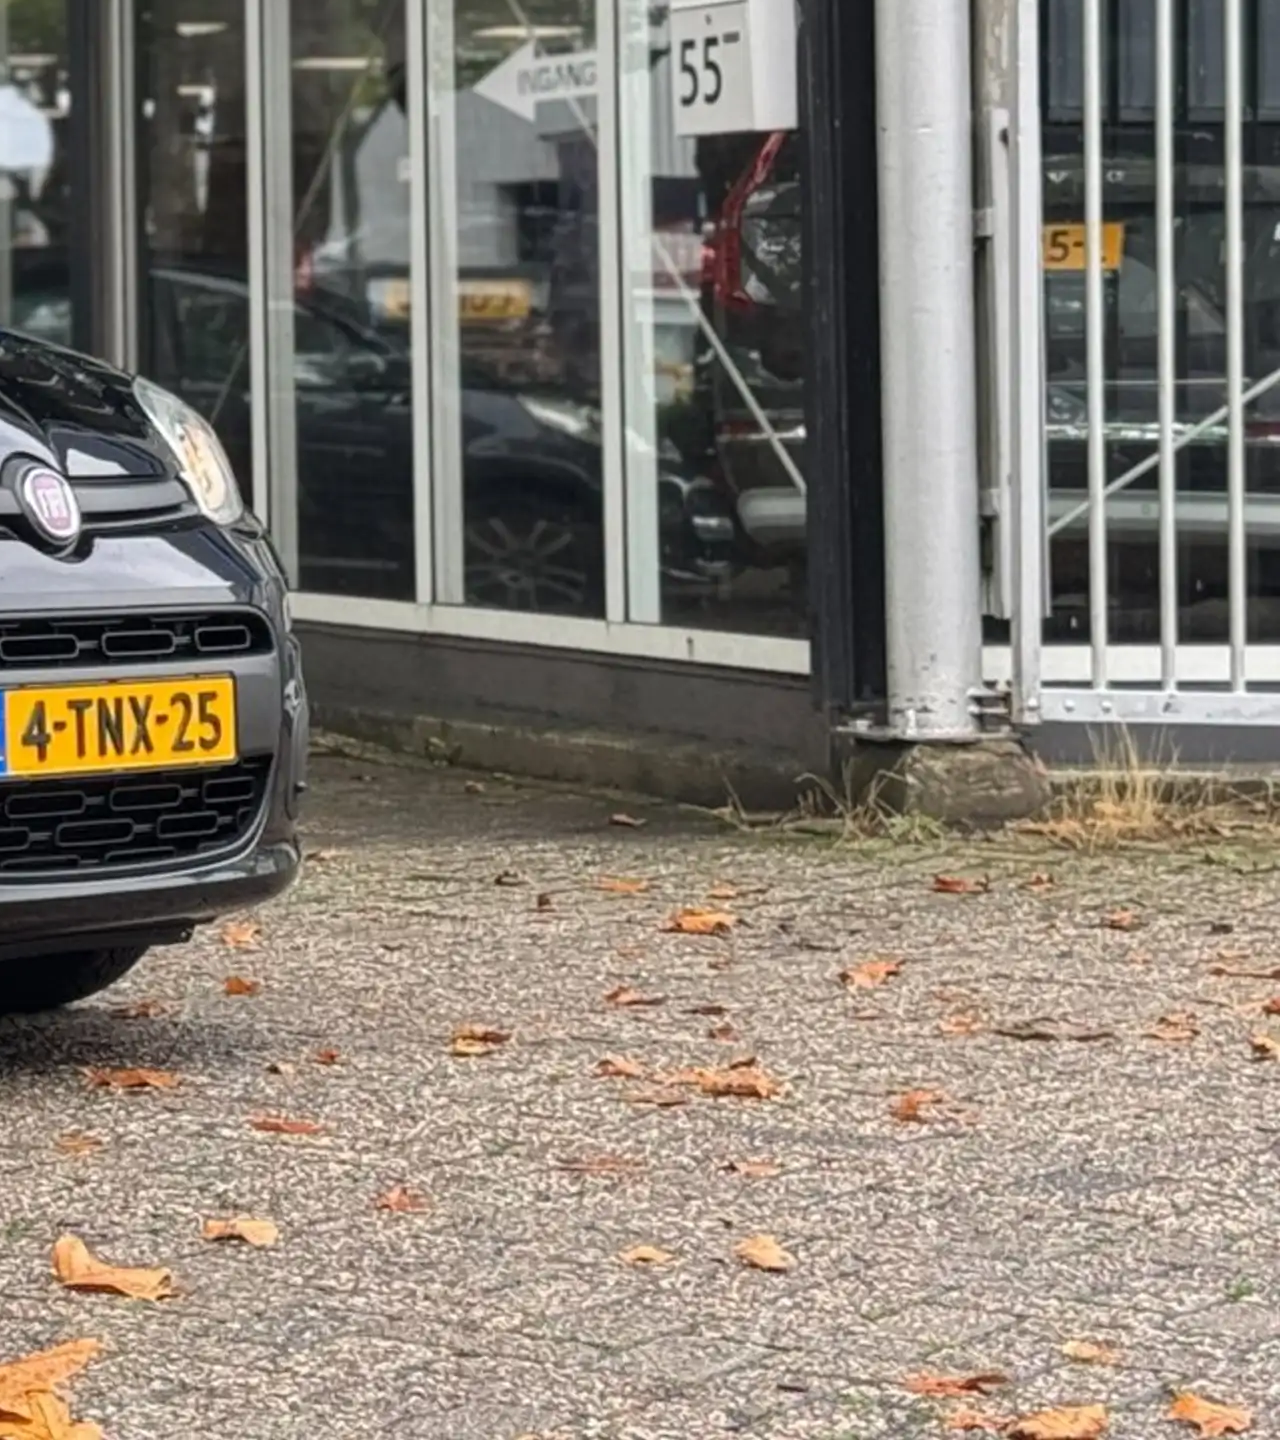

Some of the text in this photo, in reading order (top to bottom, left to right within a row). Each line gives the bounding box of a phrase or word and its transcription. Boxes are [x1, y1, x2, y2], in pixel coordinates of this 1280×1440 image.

[517, 61, 597, 97] INGANG
[680, 35, 722, 108] 55
[21, 691, 222, 763] 4-TNX-25
